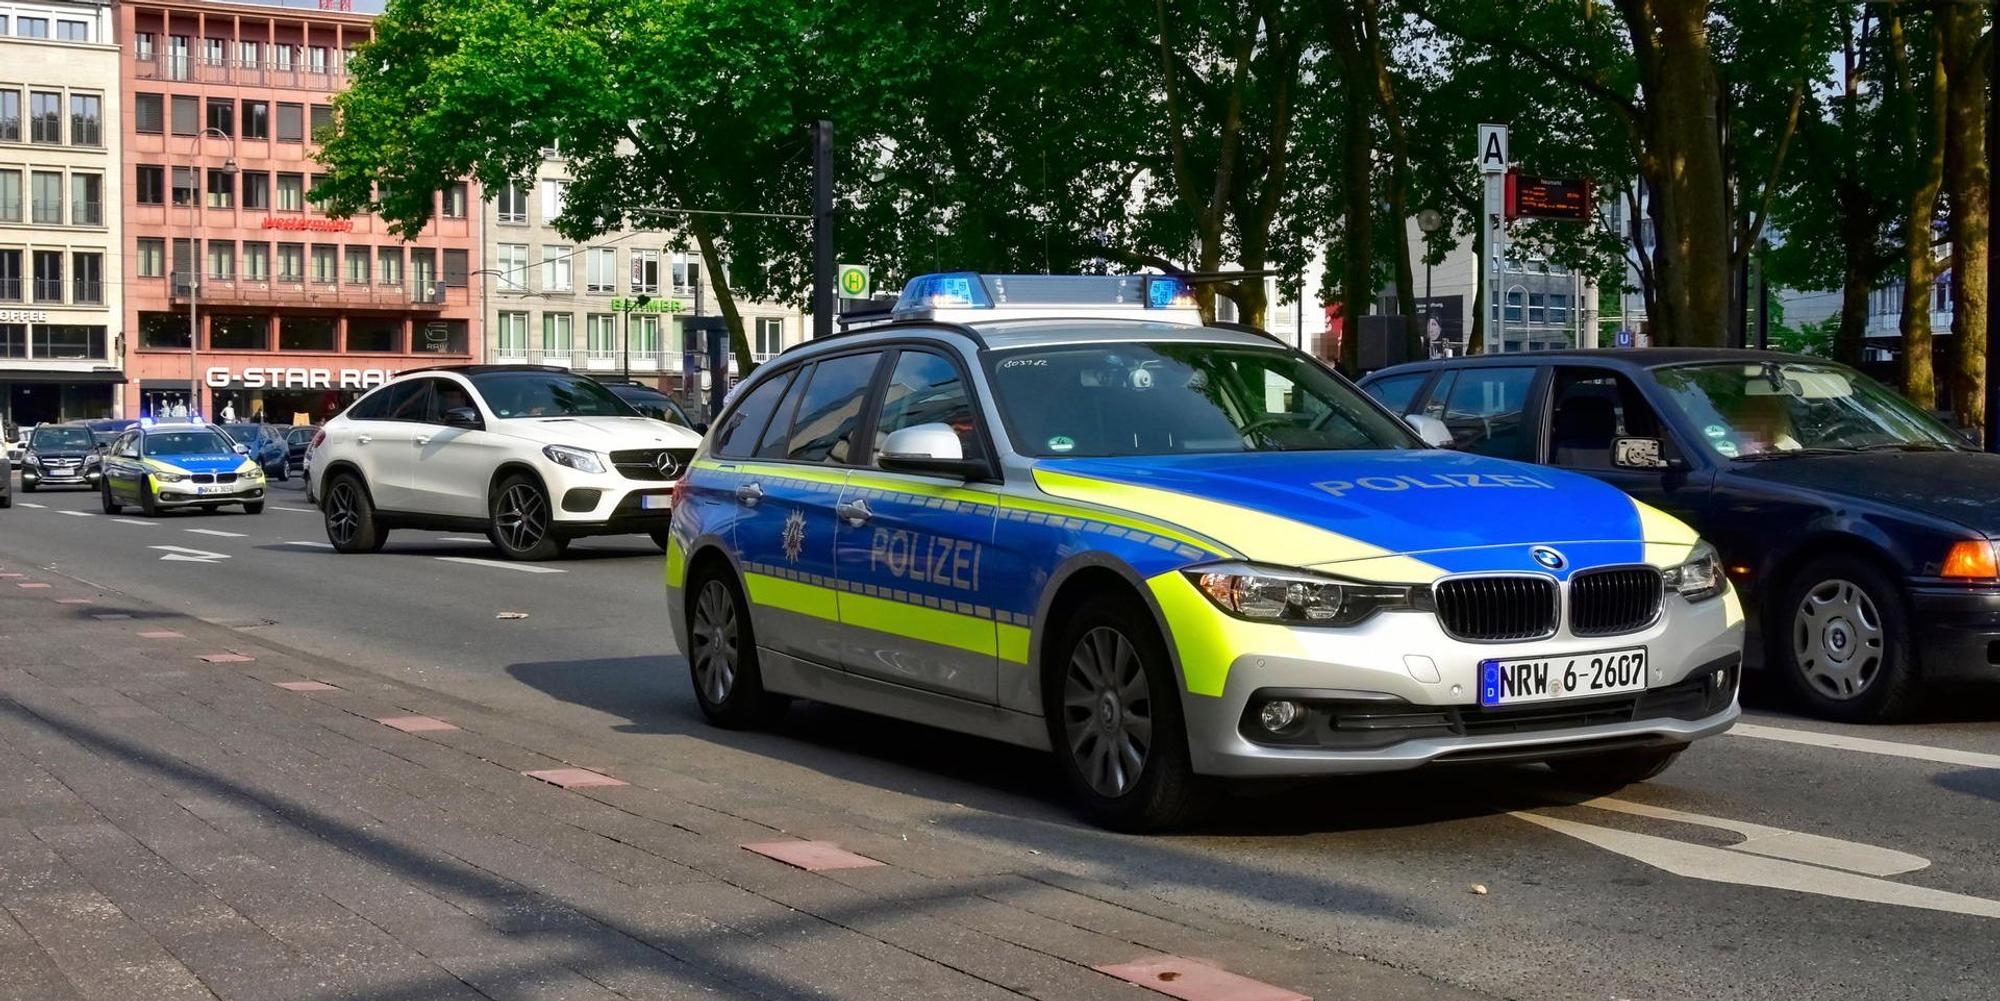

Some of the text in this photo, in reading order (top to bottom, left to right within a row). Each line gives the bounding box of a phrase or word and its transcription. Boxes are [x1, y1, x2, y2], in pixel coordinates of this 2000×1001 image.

[1484, 132, 1504, 164] A
[849, 274, 859, 288] H
[1620, 334, 1629, 344] U
[206, 367, 331, 388] G-STAR
[1310, 474, 1555, 497] POLIZEI
[871, 527, 982, 592] POLIZEI
[1500, 653, 1644, 698] NRW 6-2607
[1487, 687, 1495, 697] D
